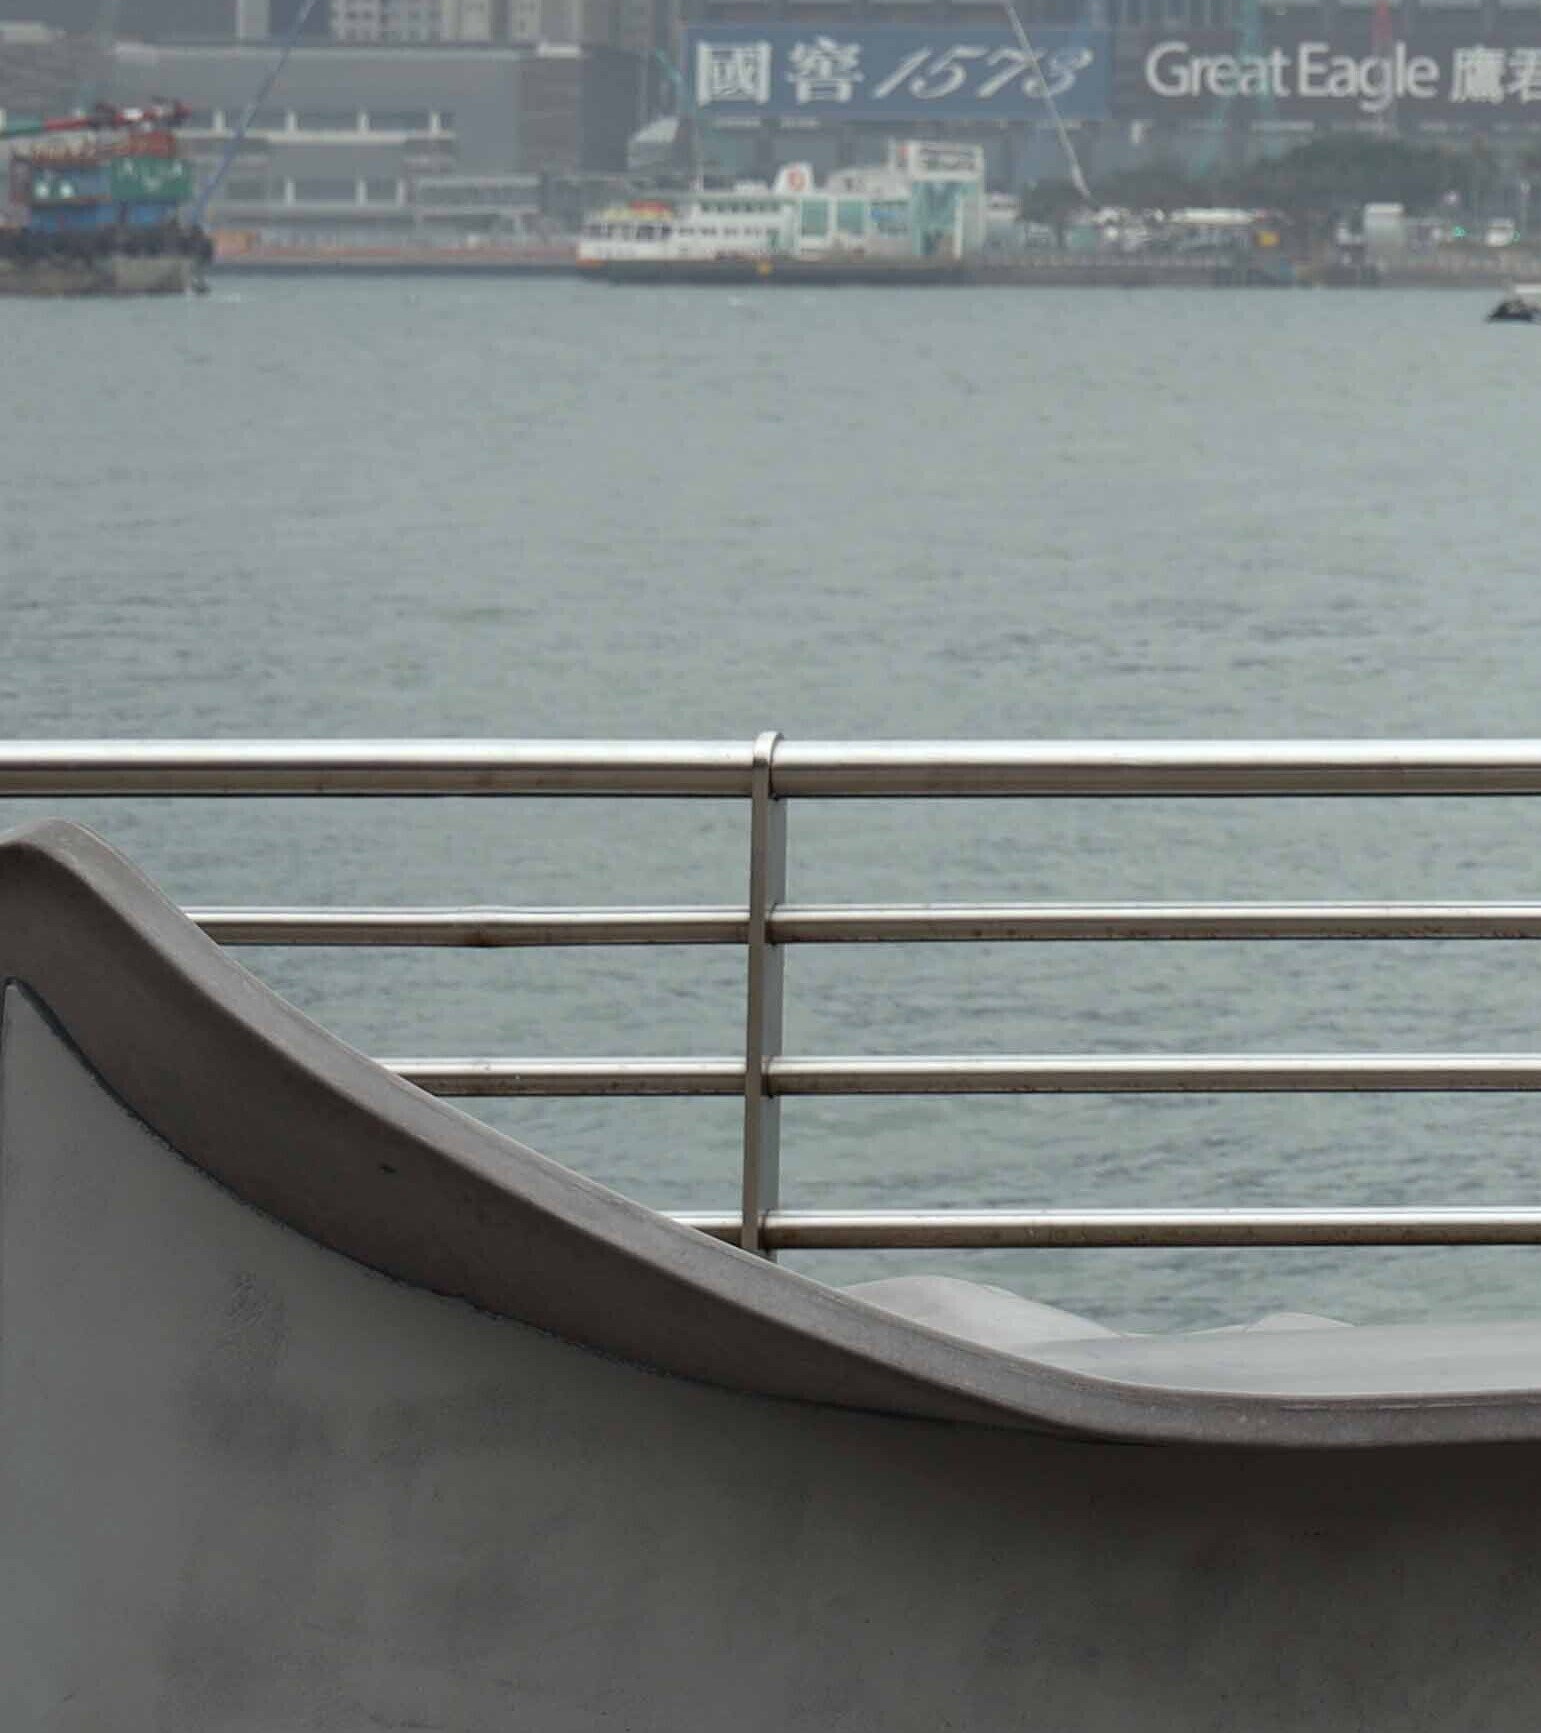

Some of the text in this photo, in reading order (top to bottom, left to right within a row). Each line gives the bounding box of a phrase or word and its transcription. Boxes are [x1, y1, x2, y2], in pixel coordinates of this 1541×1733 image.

[696, 35, 1095, 105] 國窖 1573
[1144, 40, 1292, 98] Great
[1297, 40, 1441, 114] Eagle
